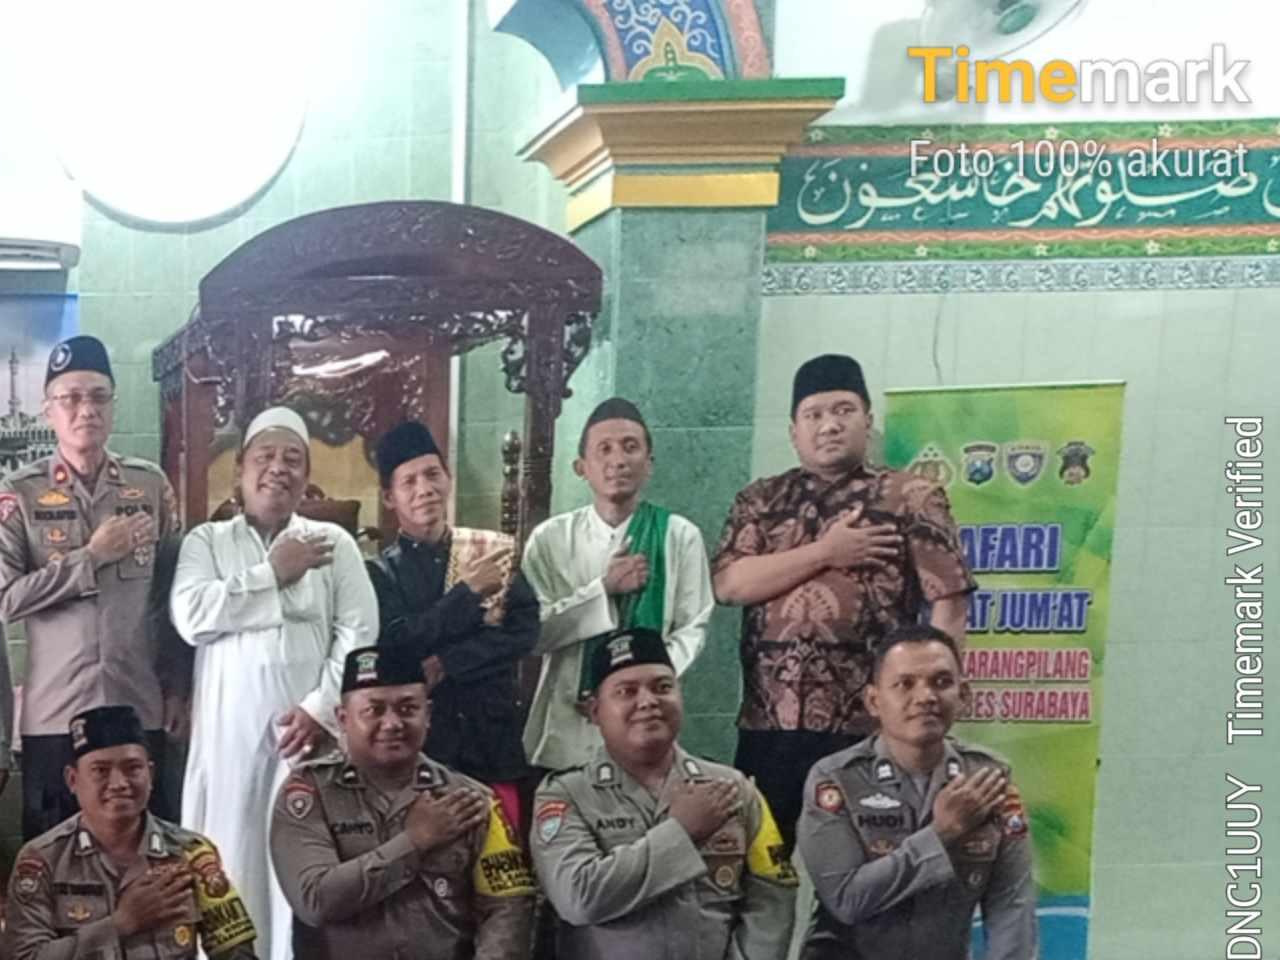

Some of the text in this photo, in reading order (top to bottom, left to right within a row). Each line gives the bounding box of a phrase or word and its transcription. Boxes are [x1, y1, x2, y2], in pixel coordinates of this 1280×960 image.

[960, 525, 1061, 571] AFARI
[962, 650, 1090, 680] ARANGPILANG
[1001, 690, 1090, 719] SURABAYA
